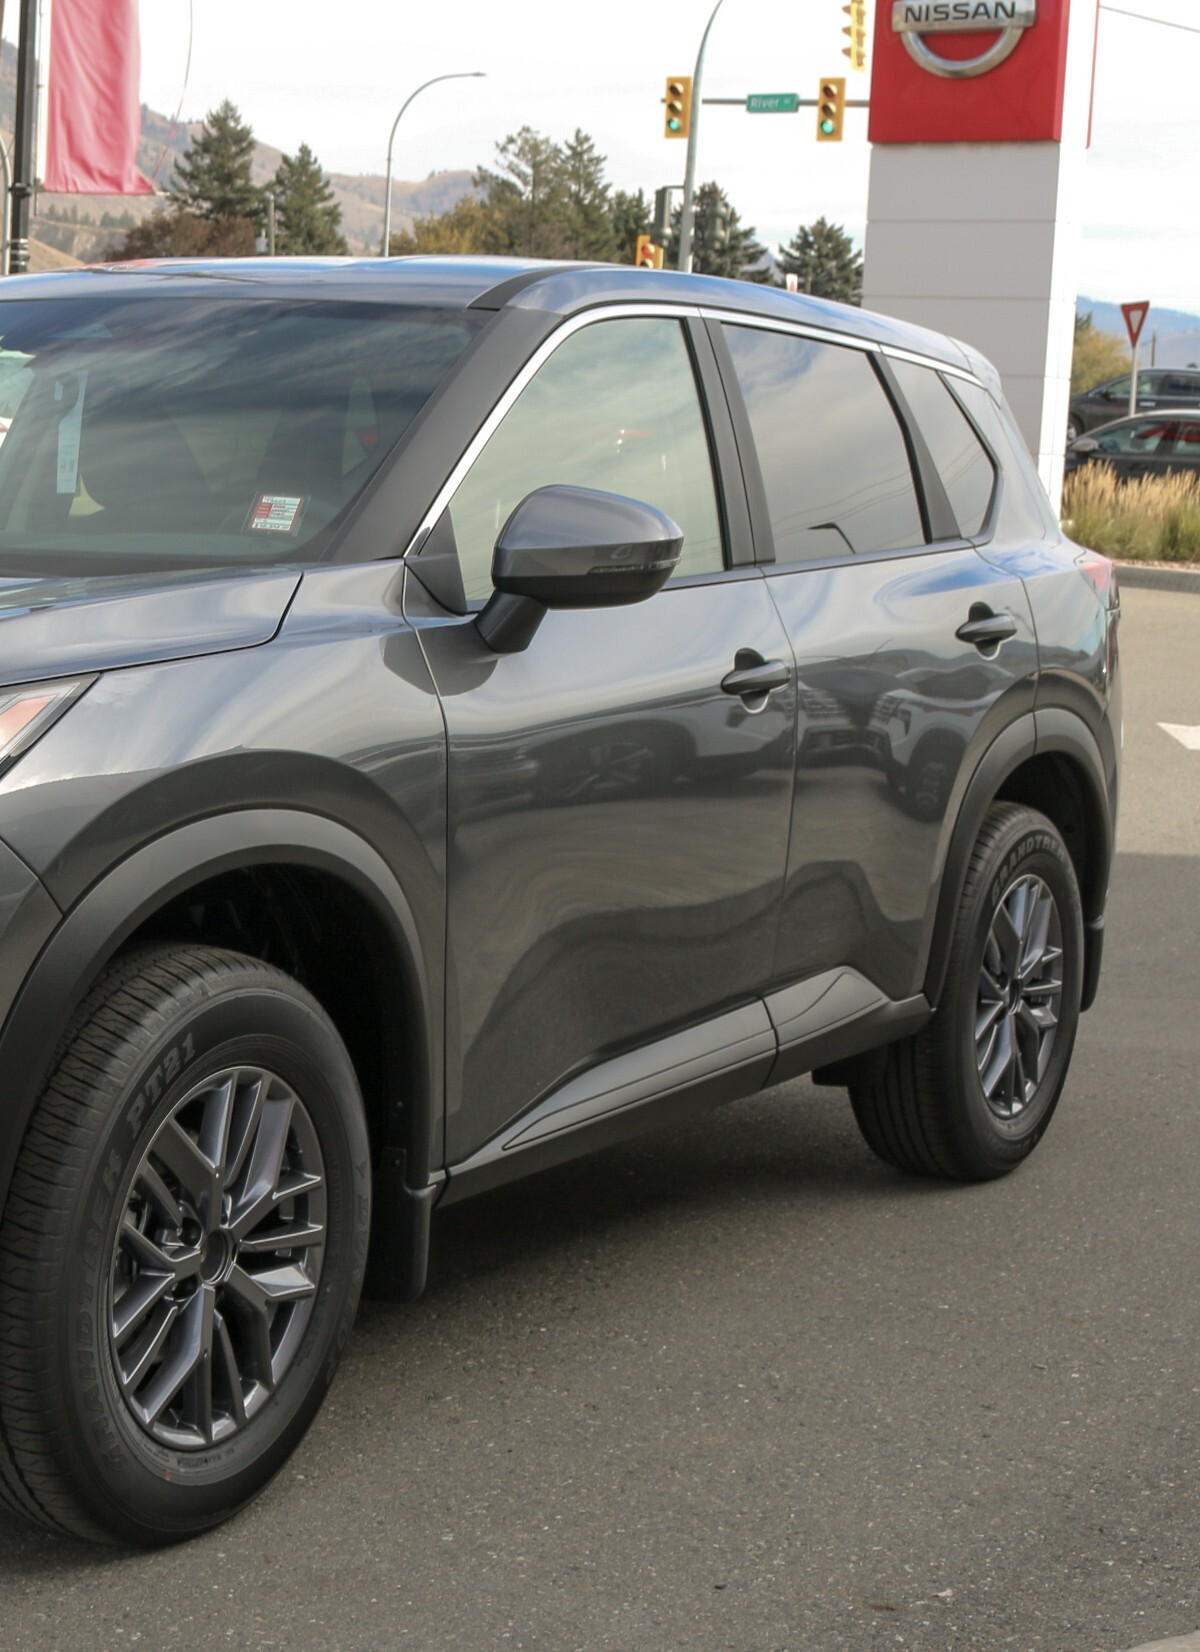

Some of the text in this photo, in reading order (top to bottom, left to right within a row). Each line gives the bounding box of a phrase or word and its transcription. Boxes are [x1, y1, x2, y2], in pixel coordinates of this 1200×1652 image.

[904, 2, 1016, 23] NISSAN
[751, 96, 779, 109] River
[126, 1032, 196, 1140] PT21
